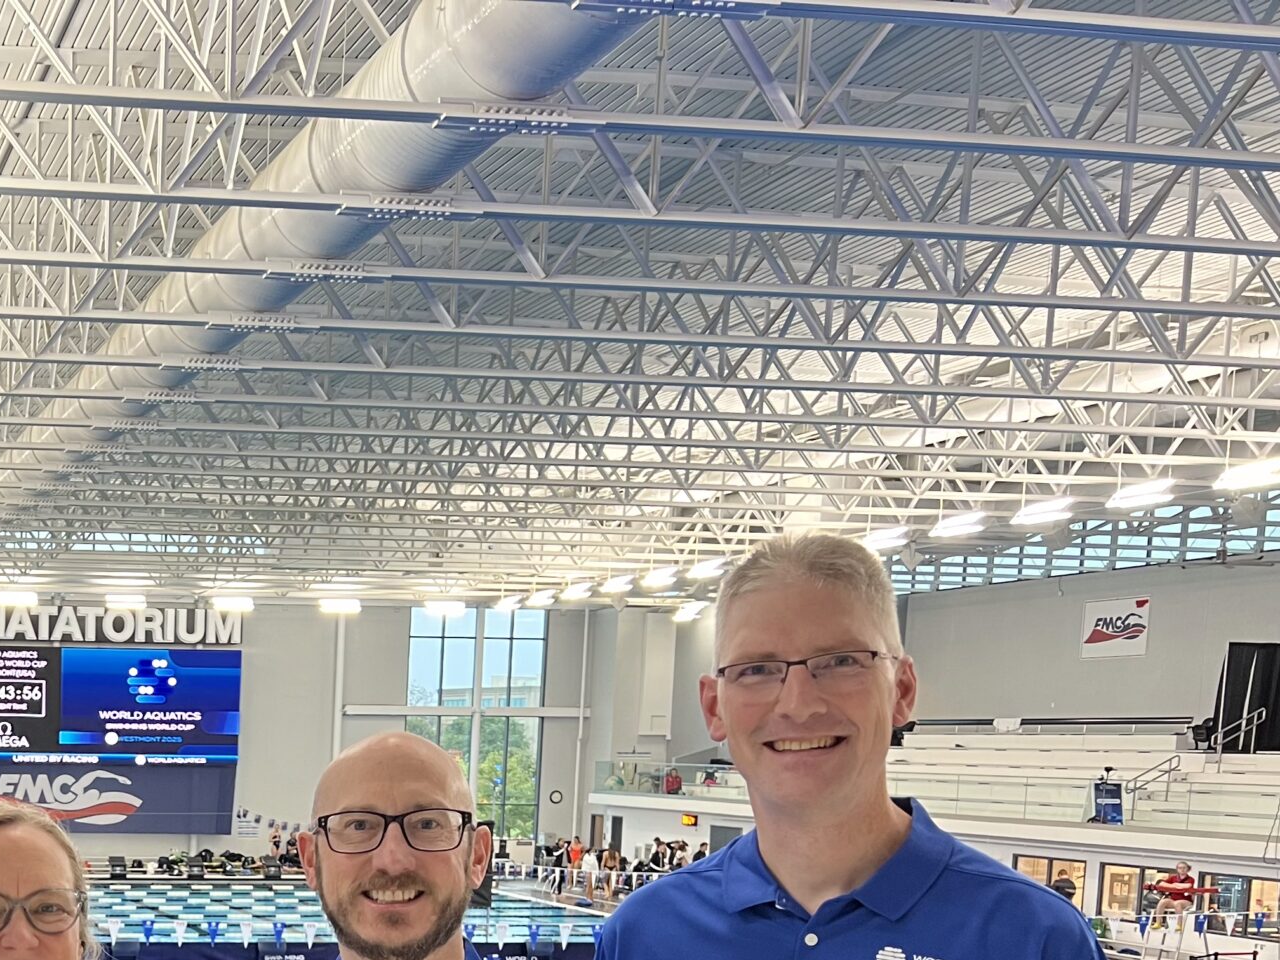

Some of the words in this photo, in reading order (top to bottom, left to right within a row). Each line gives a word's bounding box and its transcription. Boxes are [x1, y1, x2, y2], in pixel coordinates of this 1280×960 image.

[1094, 616, 1123, 632] FMC
[99, 710, 143, 720] WORLD
[143, 711, 202, 721] AQUATICS
